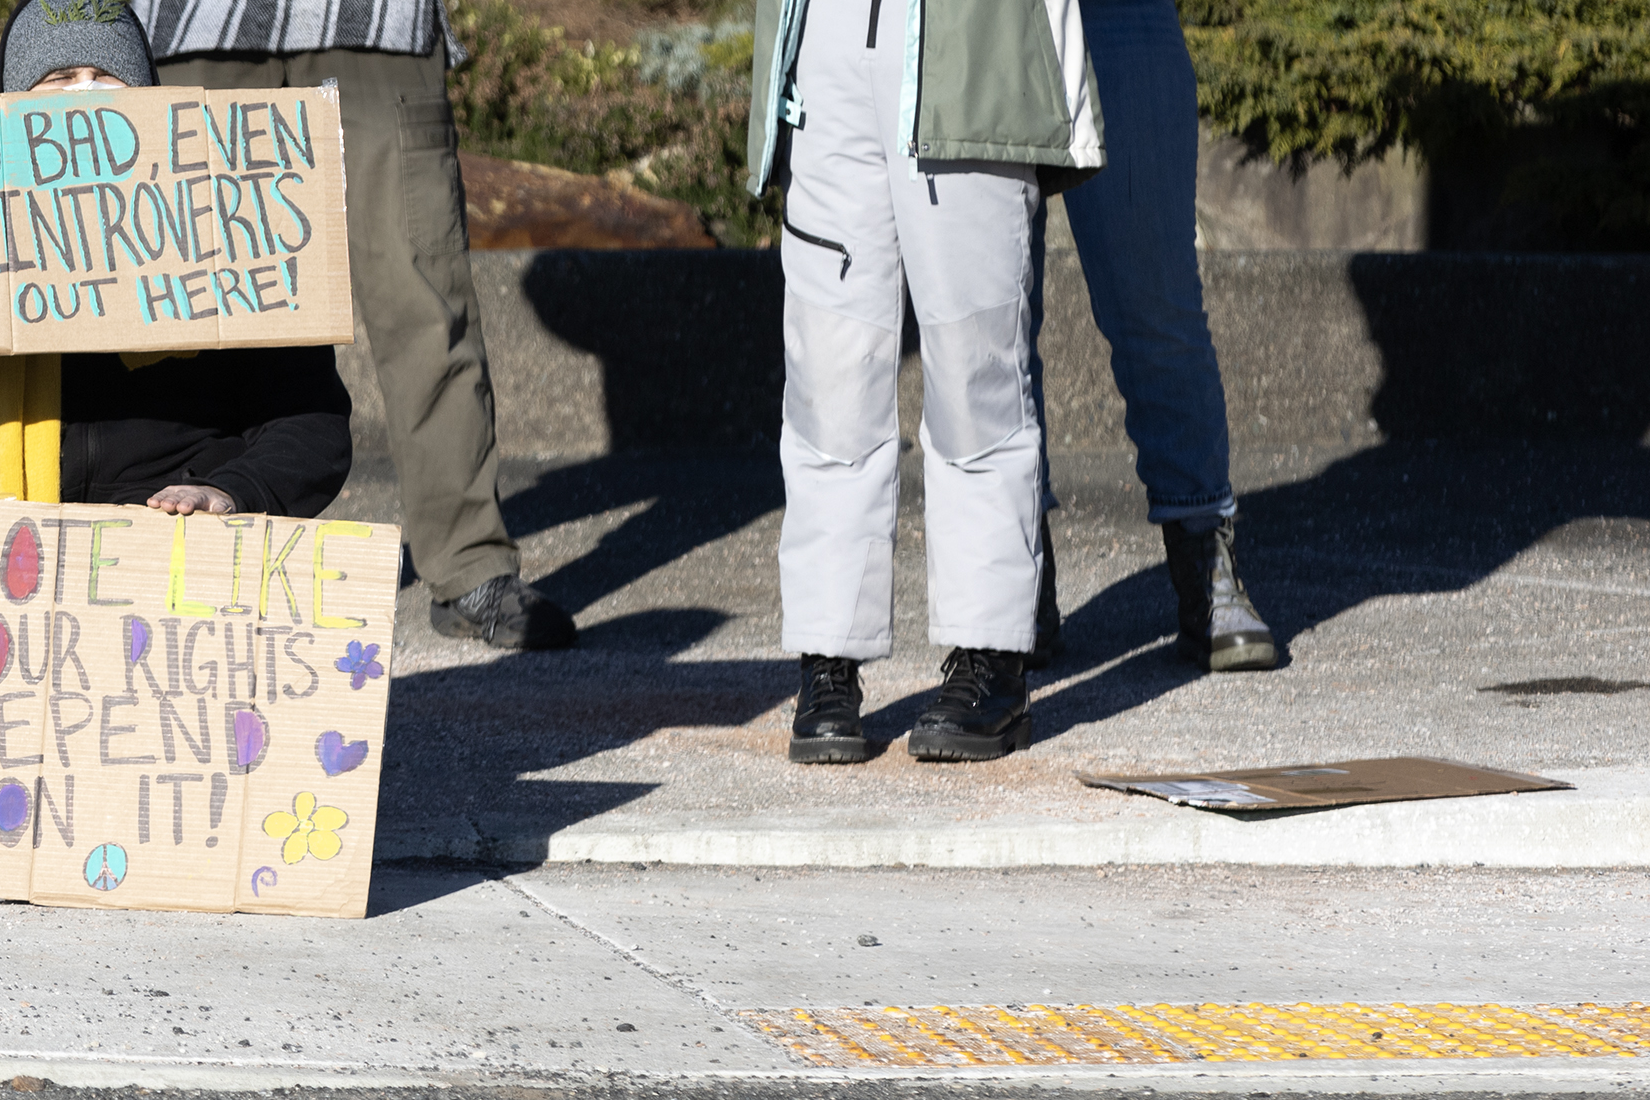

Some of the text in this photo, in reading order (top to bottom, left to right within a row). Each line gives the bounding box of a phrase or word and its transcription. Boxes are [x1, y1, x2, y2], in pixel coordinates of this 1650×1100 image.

[169, 99, 315, 174] EVEN
[16, 276, 118, 324] OUT
[135, 255, 300, 325] HERE!
[165, 514, 373, 629] LIKE
[119, 614, 319, 704] RIGHTS
[137, 772, 229, 848] IT!
